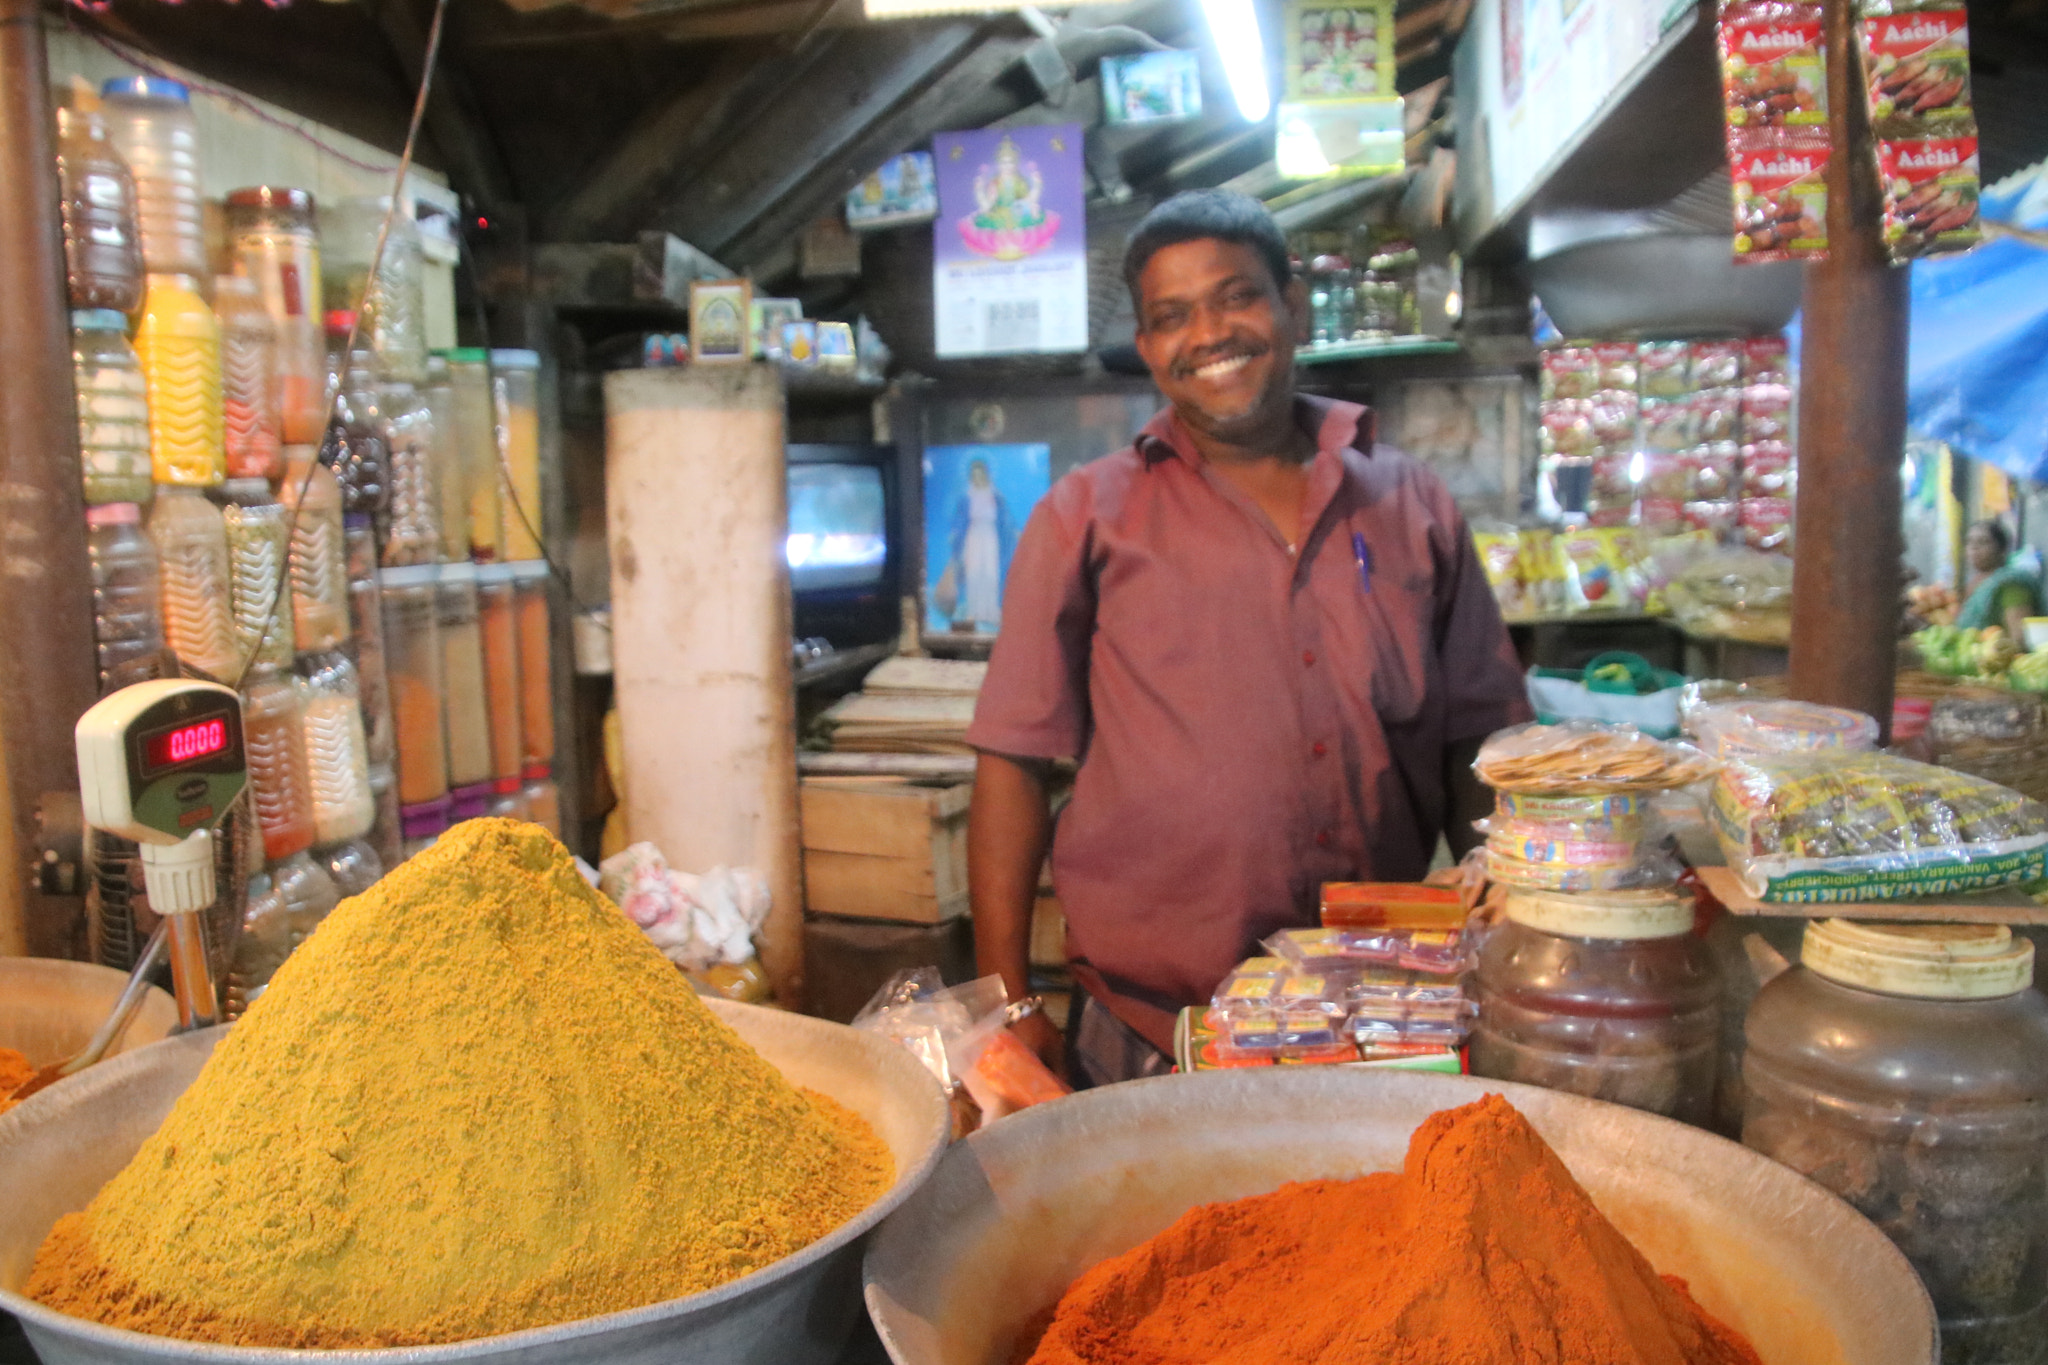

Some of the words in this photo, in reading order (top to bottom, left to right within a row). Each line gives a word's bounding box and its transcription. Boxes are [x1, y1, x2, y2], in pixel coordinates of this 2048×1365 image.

[1741, 30, 1805, 47] Aachi
[1884, 20, 1948, 42] Aachi
[1751, 157, 1812, 175] Aachi
[1898, 148, 1960, 167] Aachi
[171, 722, 221, 759] 0.000
